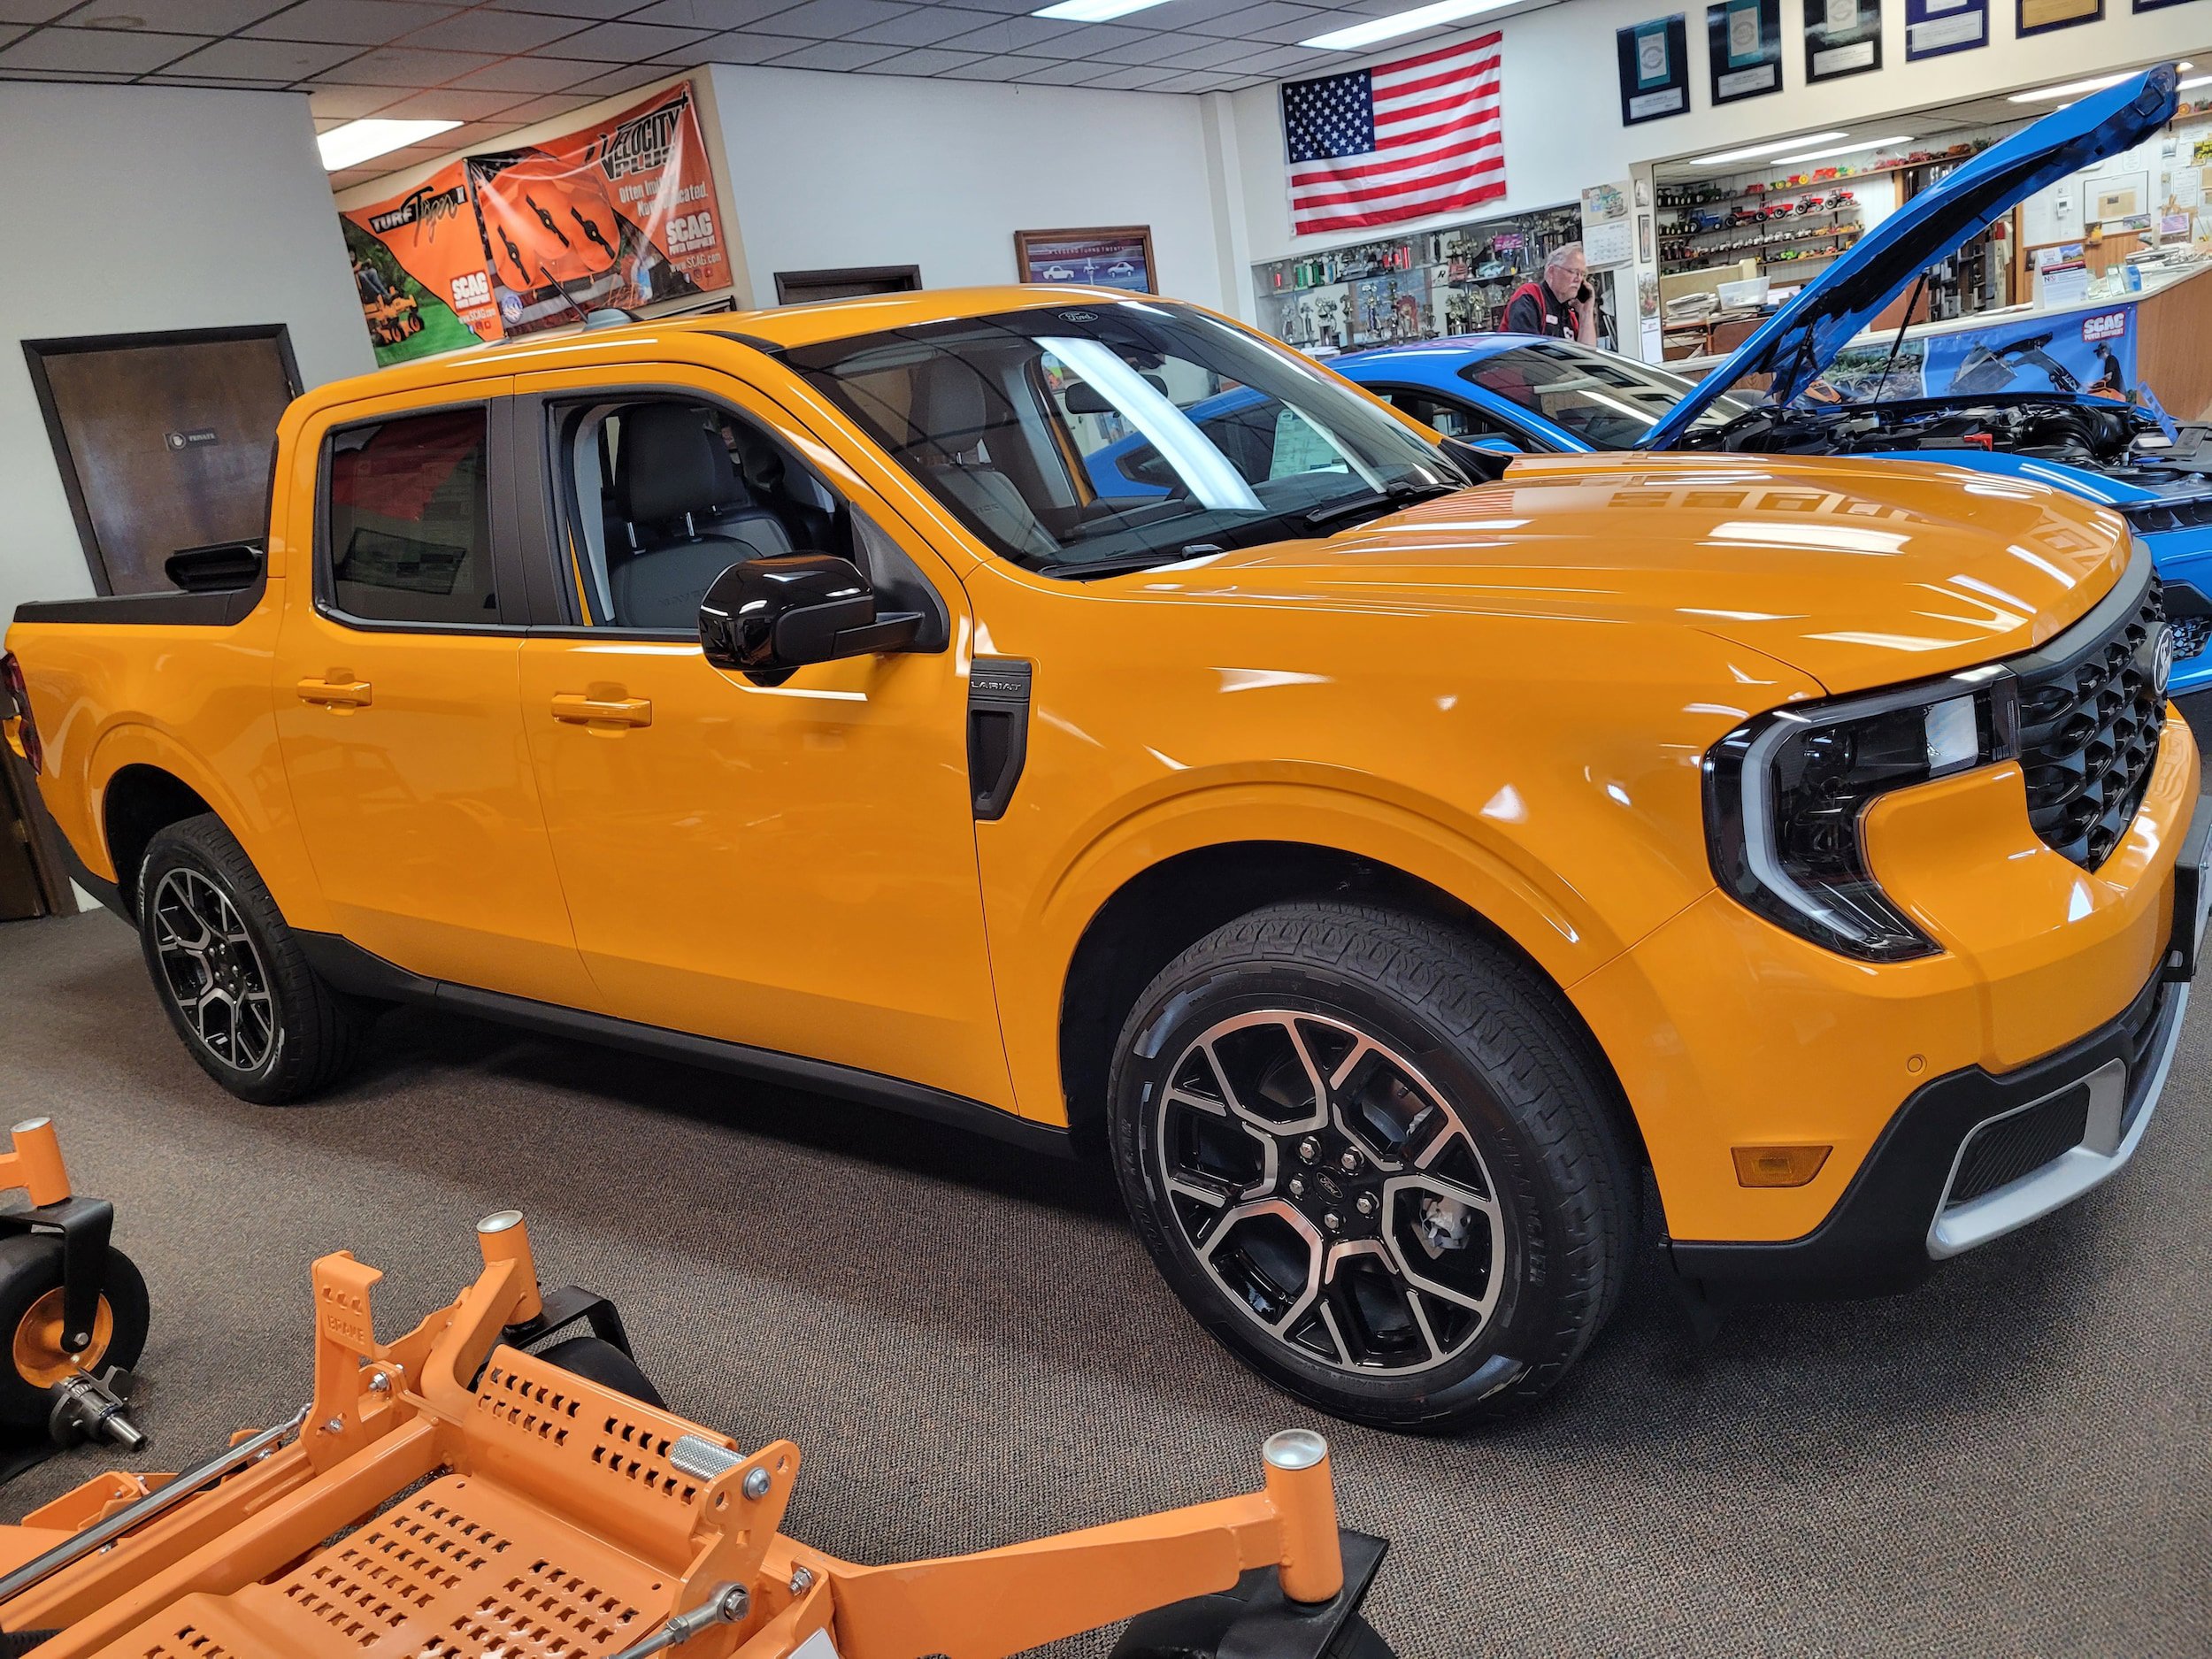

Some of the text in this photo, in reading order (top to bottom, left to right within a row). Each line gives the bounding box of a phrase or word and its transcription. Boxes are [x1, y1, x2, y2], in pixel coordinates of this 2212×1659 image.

[601, 107, 680, 180] VELOCITY
[619, 183, 644, 204] Often
[373, 206, 413, 232] TURF
[400, 186, 458, 248] Tiger
[666, 212, 713, 245] SCAG
[452, 272, 488, 301] SCAG
[1064, 312, 1094, 321] Ford
[2084, 312, 2125, 334] SCAG
[971, 680, 1022, 691] LARIAT
[1319, 1177, 1339, 1194] Ford
[327, 1315, 365, 1344] BRAKE
